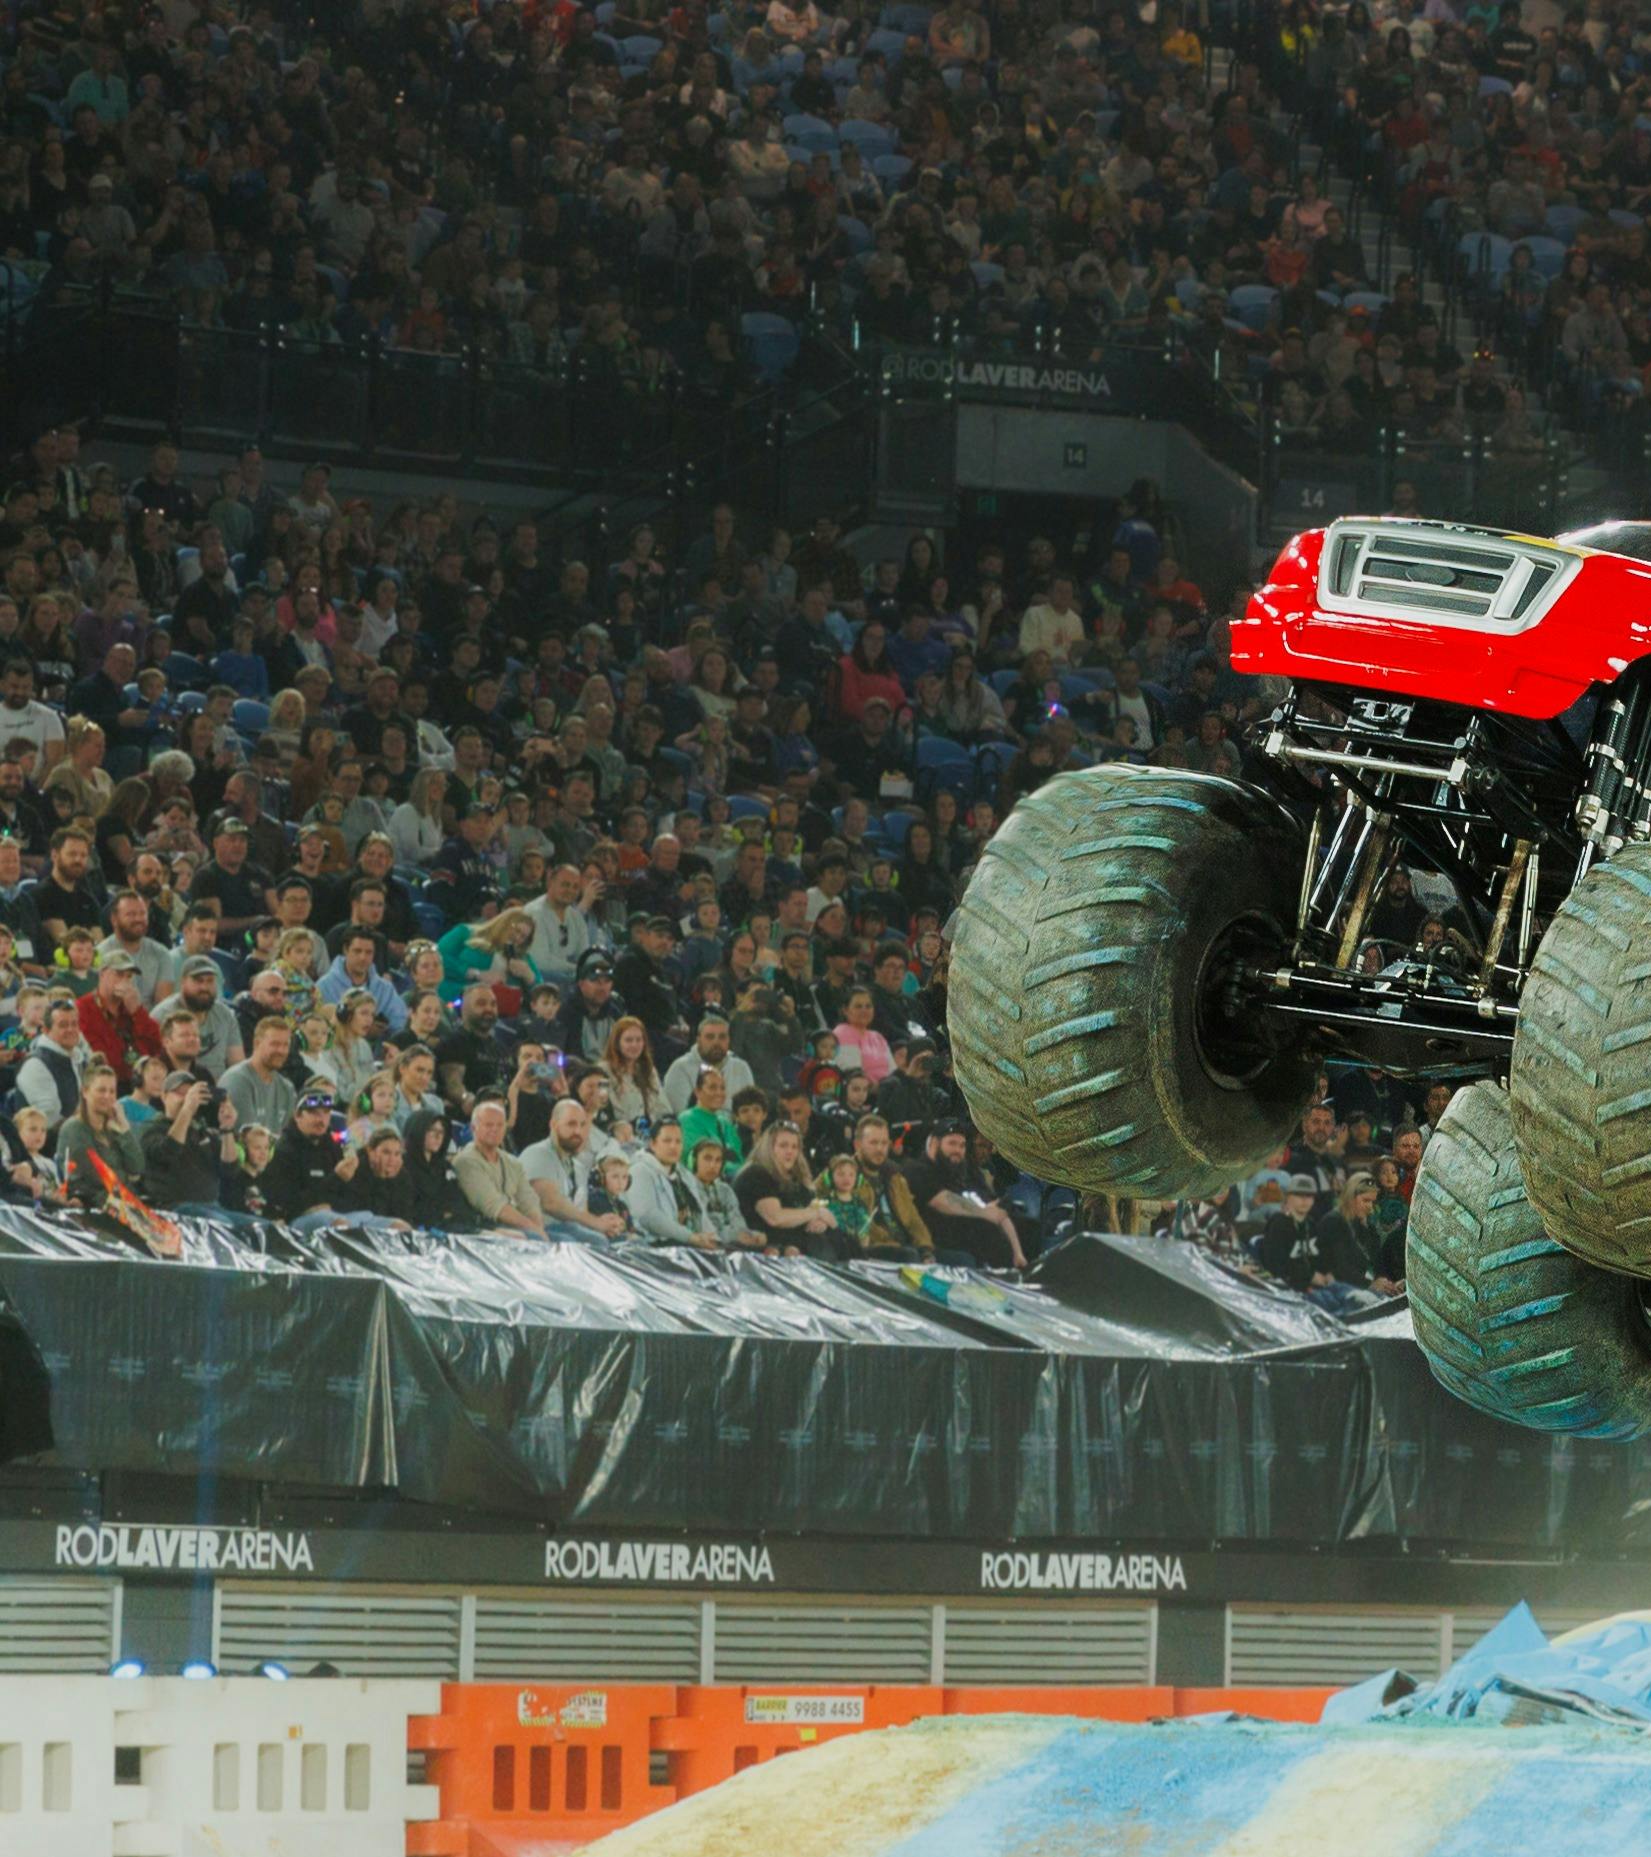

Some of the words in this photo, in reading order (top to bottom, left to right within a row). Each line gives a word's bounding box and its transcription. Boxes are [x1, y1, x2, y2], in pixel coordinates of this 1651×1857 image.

[1066, 447, 1085, 465] 14
[1301, 487, 1326, 508] 14
[794, 1701, 826, 1718] 9988
[830, 1702, 861, 1718] 4455
